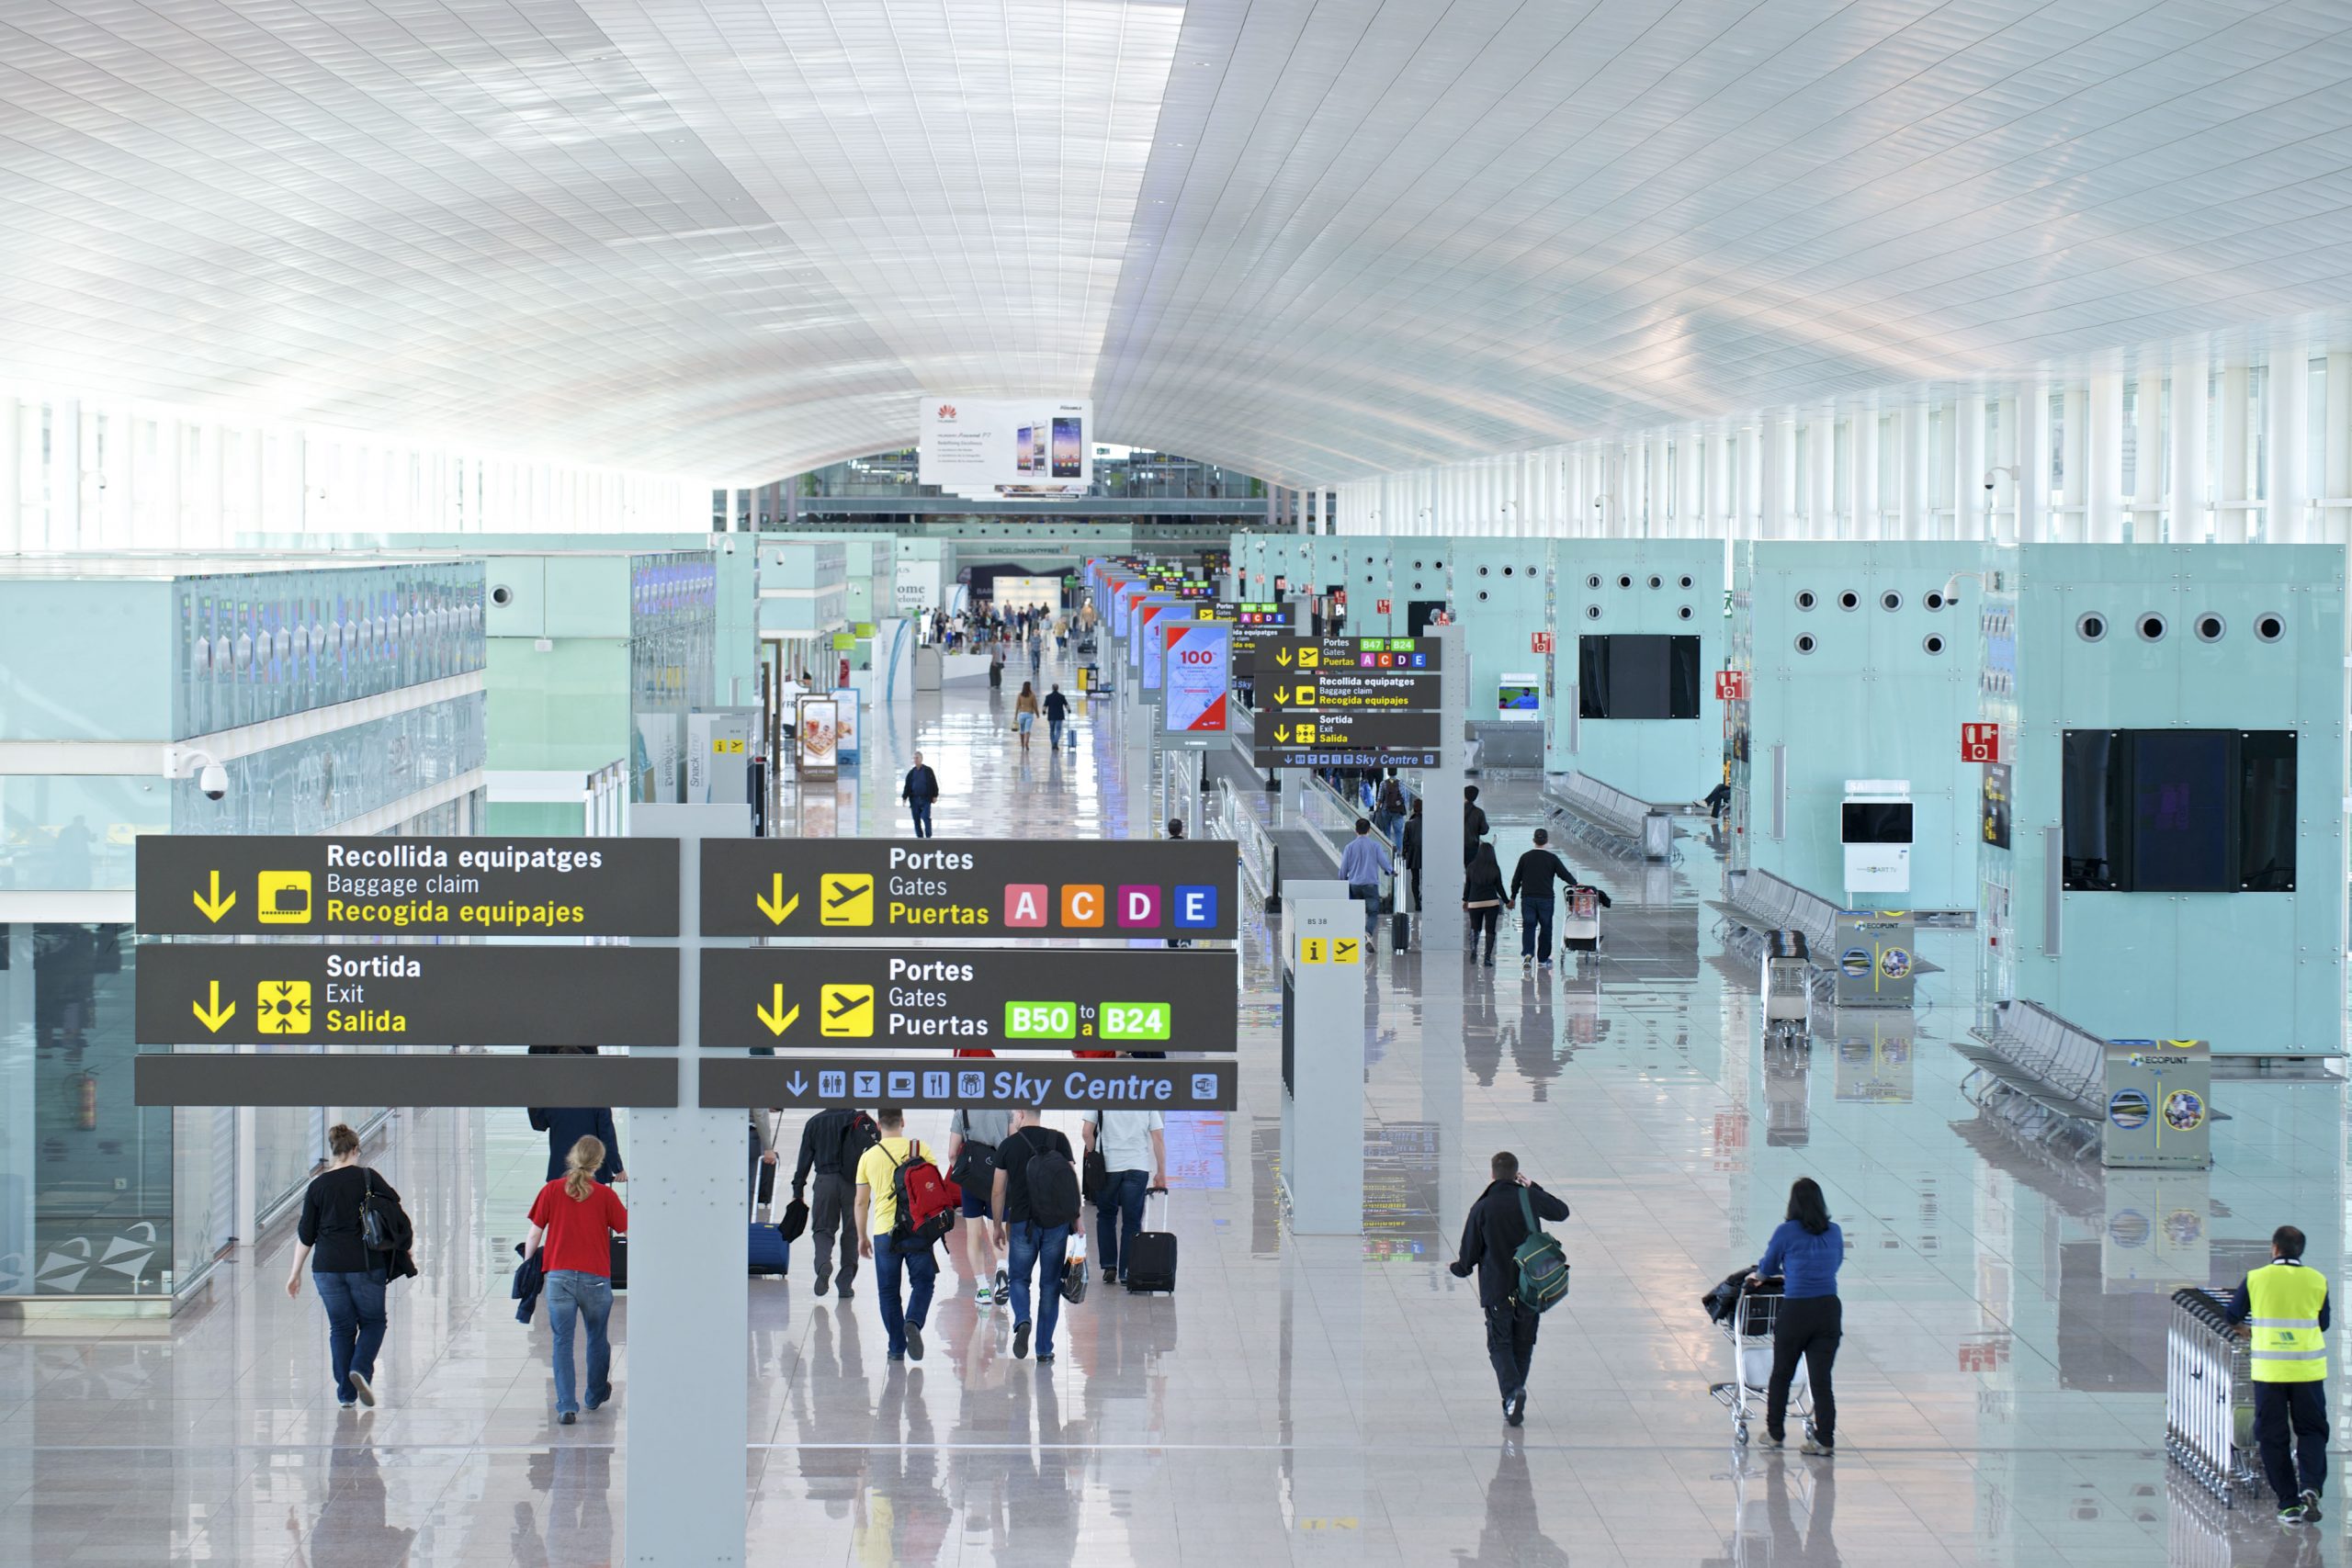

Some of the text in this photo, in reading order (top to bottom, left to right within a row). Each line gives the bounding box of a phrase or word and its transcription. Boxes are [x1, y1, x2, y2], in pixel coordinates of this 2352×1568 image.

[1323, 638, 1350, 647] Portes
[1363, 640, 1382, 649] B47
[1393, 640, 1412, 649] B24
[1323, 655, 1422, 666] Puertas A C D E
[1319, 677, 1415, 688] Recollida equipatges
[1319, 687, 1351, 695] Baggage
[1319, 696, 1408, 705] Recogida equipajes
[1319, 716, 1352, 724] Sortida
[1319, 734, 1348, 742] Salida
[1355, 754, 1376, 766] Sky
[1380, 754, 1419, 765] Centre
[327, 845, 603, 873] Recollida equipatges
[889, 848, 974, 870] Portes
[327, 874, 480, 897] Baggage claim
[888, 876, 947, 897] Gates
[327, 900, 584, 926] Recogida equipajes
[889, 892, 1204, 925] Puertas A C D E
[327, 954, 422, 978] Sortida
[889, 958, 974, 981] Portes
[327, 983, 364, 1003] Exit
[888, 987, 1095, 1019] Gates to
[327, 1010, 407, 1032] Salida
[889, 1008, 1163, 1036] Puertas B50 a B24
[2145, 1055, 2188, 1065] ECOPUNT
[993, 1072, 1173, 1106] Sky Centre
